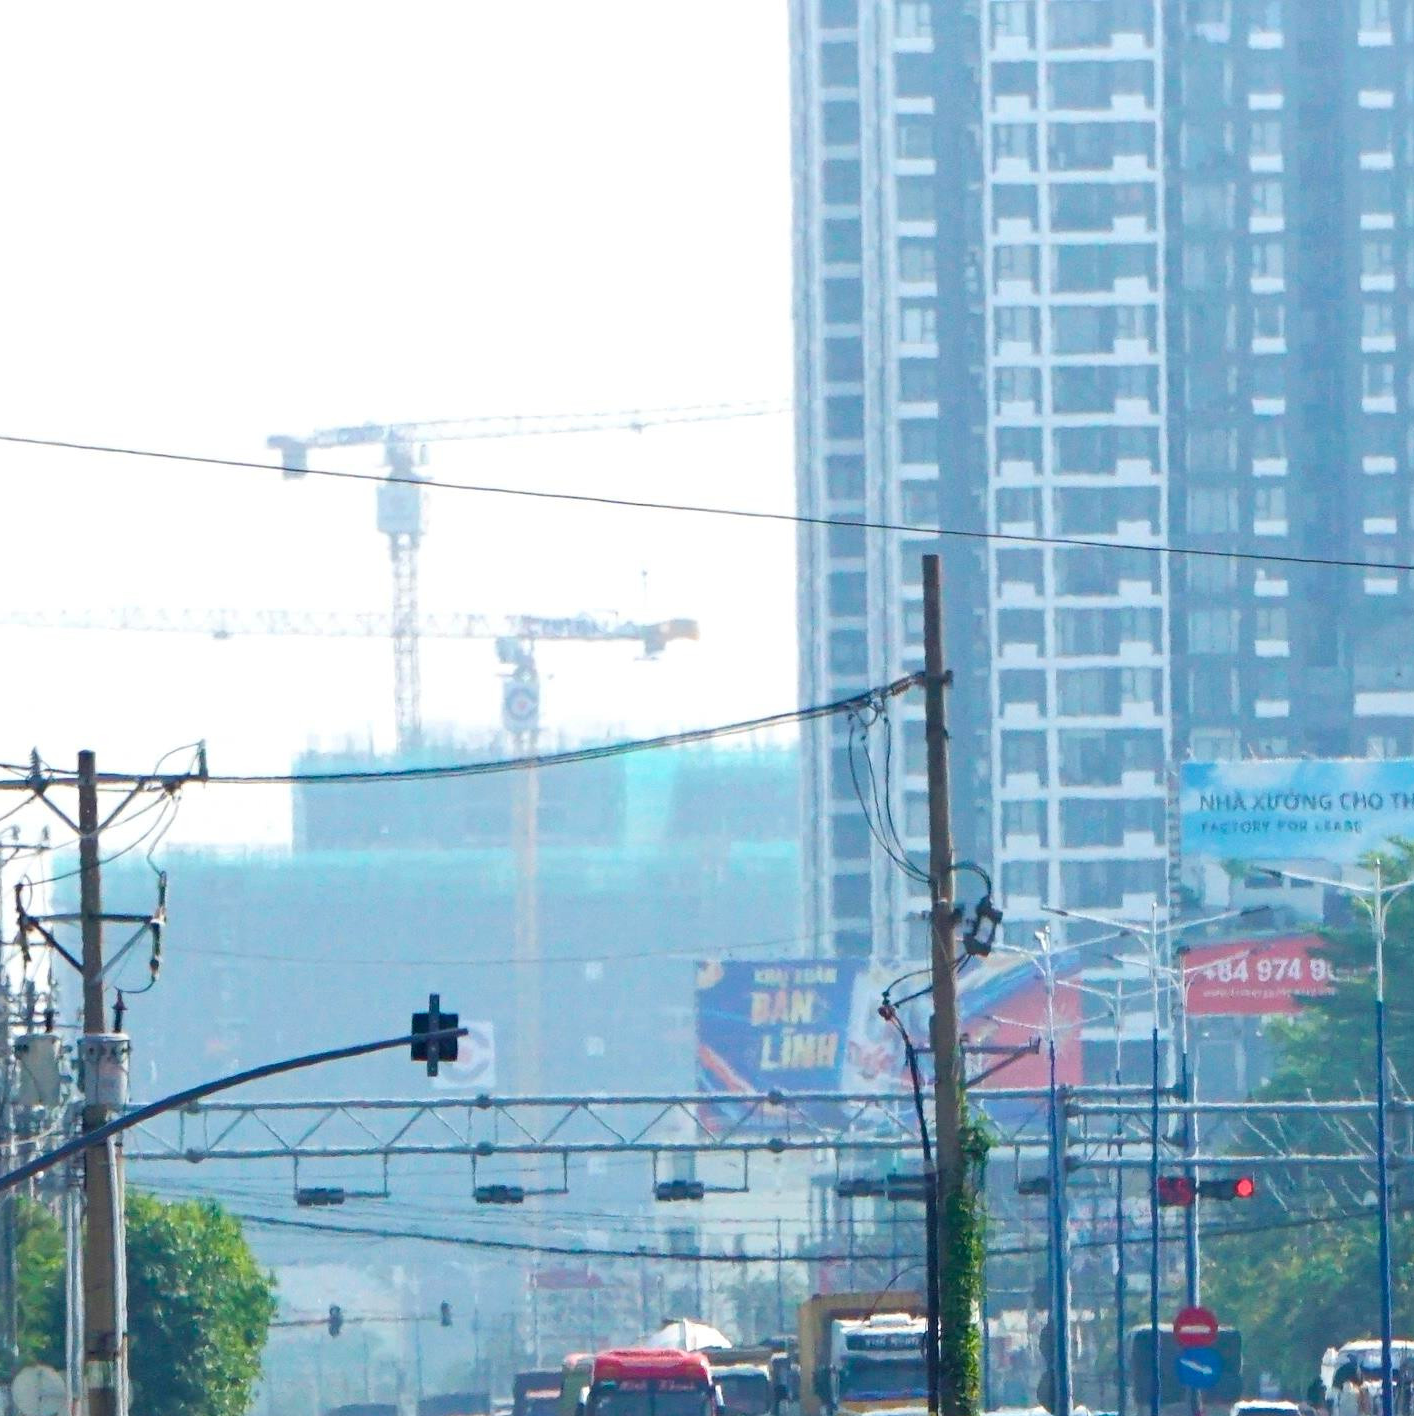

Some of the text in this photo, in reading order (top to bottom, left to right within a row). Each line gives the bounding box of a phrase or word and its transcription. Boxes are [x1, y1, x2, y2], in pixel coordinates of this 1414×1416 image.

[1338, 791, 1385, 811] CHO
[1200, 819, 1270, 834] FACTORY
[1256, 957, 1302, 982] 974
